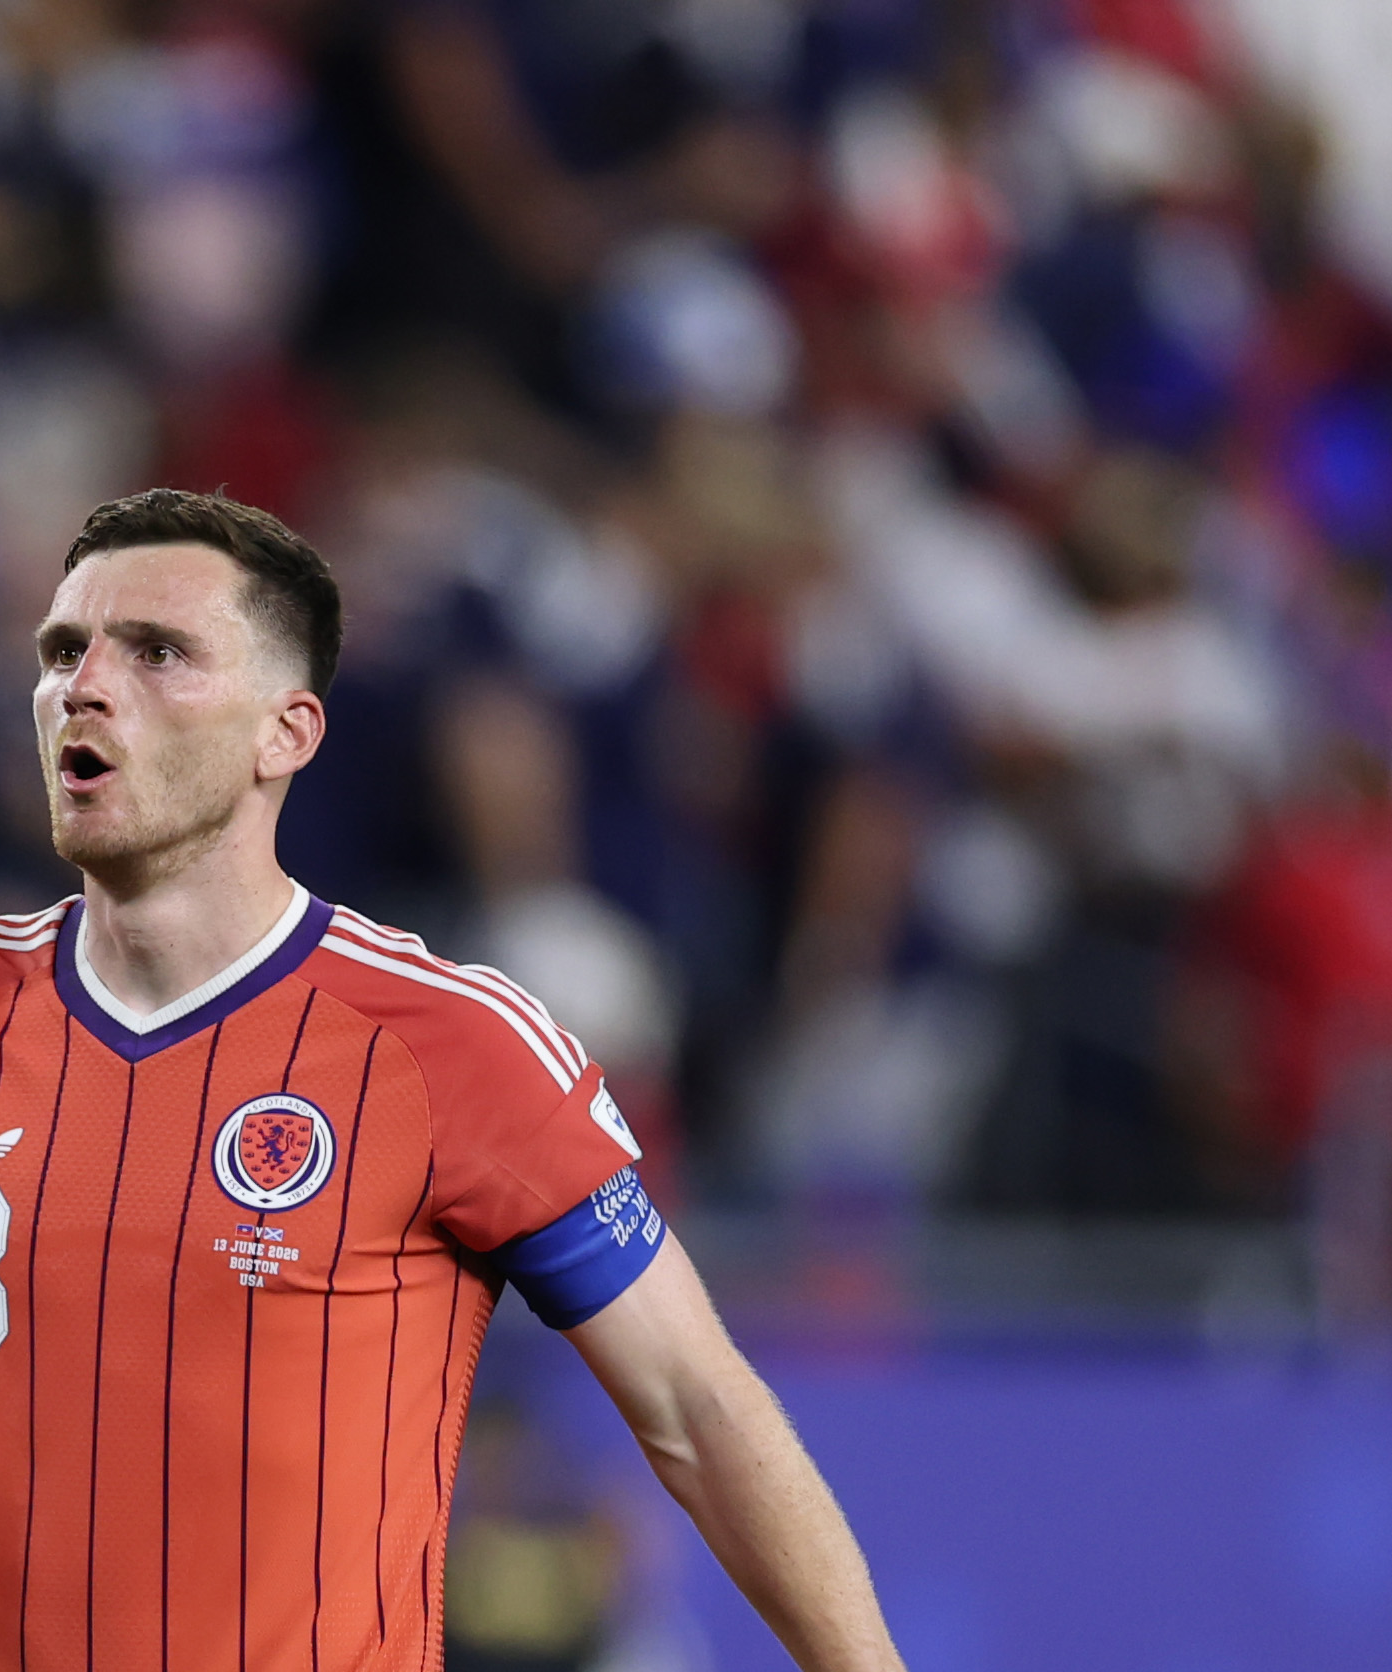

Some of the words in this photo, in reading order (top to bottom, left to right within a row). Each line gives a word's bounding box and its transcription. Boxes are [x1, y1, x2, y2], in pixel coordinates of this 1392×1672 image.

[252, 1098, 308, 1114] SCOTLAND
[226, 1179, 241, 1193] EST
[291, 1185, 312, 1201] 1873
[610, 1215, 640, 1248] the
[213, 1238, 228, 1252] 13
[229, 1240, 265, 1257] JUNE
[267, 1245, 300, 1262] 2026
[229, 1256, 280, 1275] BOSTON
[239, 1273, 265, 1288] USA
